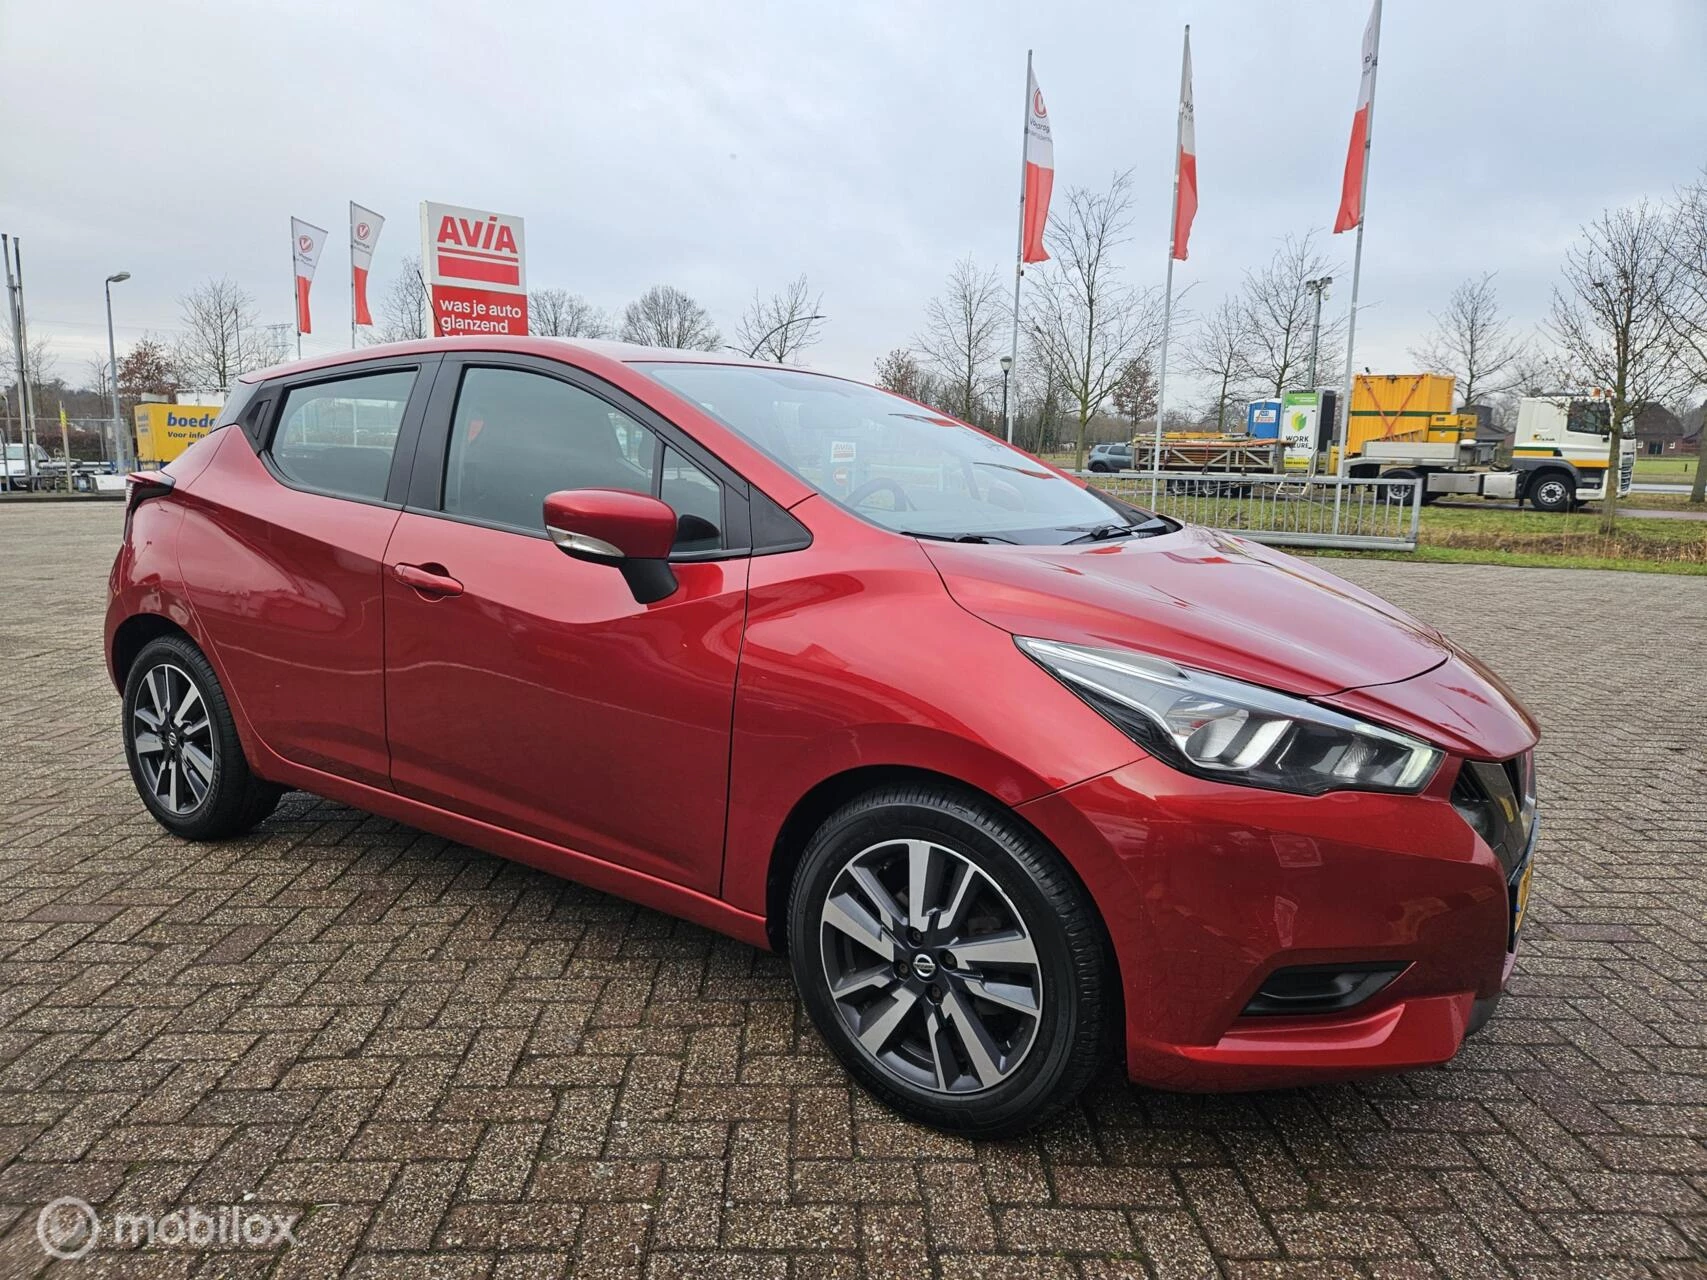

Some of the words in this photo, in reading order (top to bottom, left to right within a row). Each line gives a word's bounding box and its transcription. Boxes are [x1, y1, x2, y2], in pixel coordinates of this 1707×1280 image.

[440, 300, 471, 313] was
[472, 300, 486, 317] je
[489, 305, 521, 318] auto
[441, 314, 509, 333] glanzend
